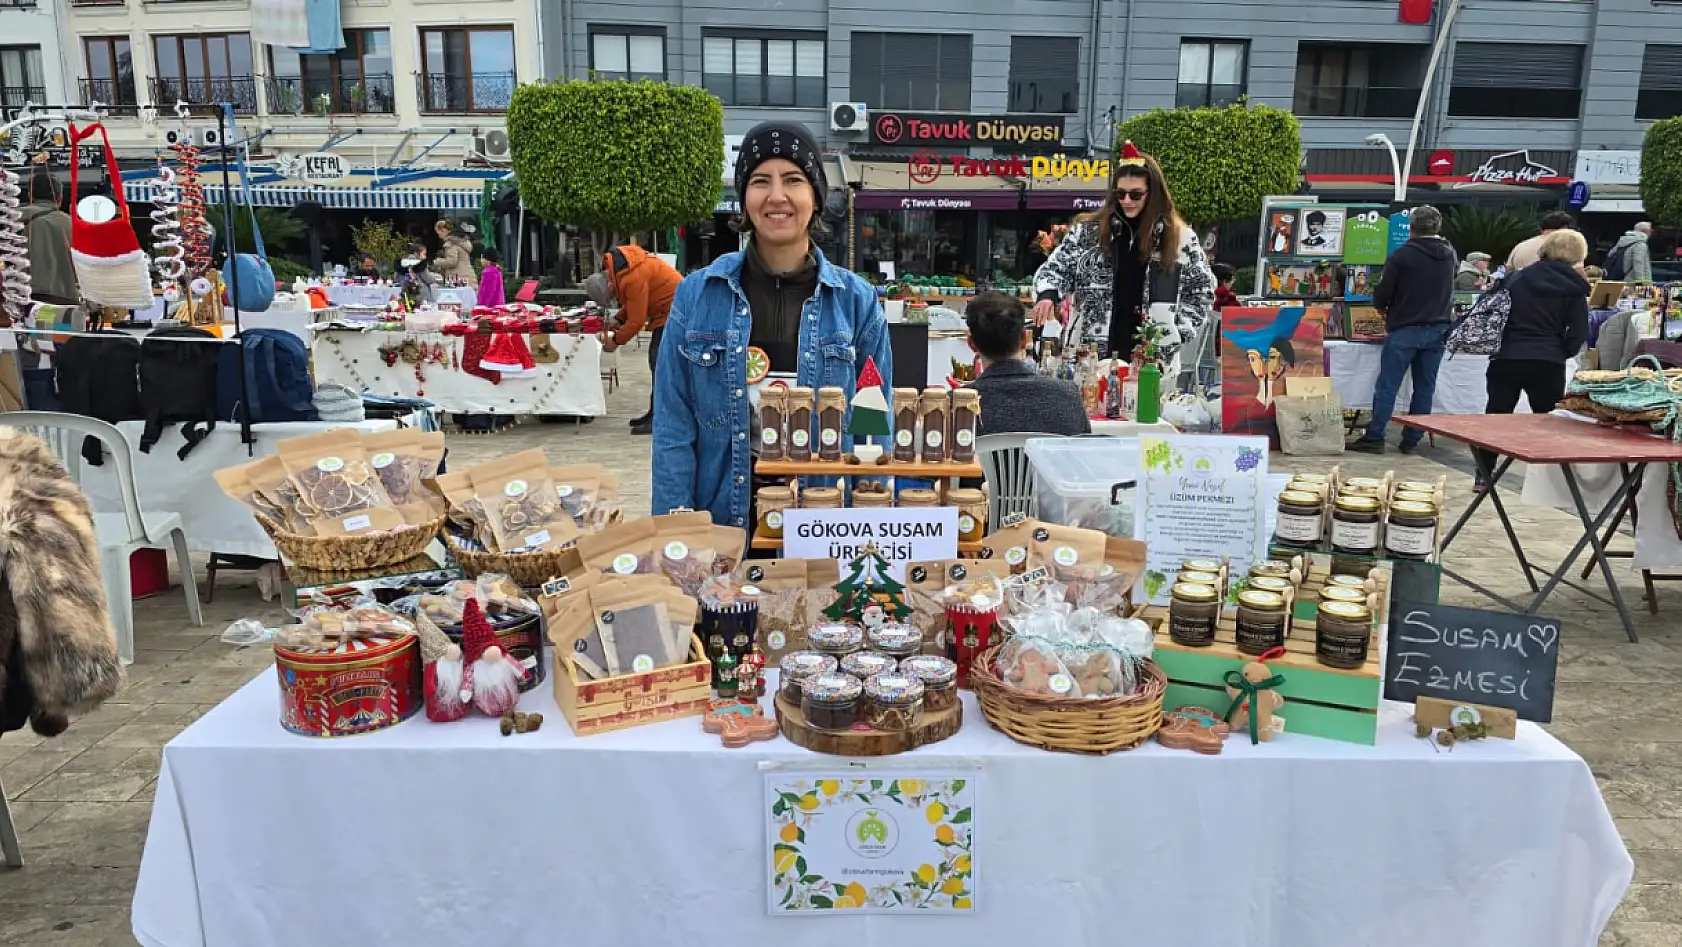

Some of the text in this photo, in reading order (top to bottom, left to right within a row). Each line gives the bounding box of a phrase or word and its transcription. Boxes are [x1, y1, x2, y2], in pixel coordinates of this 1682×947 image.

[907, 119, 1059, 144] Tavuk Dünyası
[306, 156, 343, 173] KEFAL
[949, 154, 1027, 179] Tavuk
[1472, 164, 1541, 182] Pizza Hut
[912, 199, 936, 207] Tavuk
[1170, 492, 1195, 502] ÜZÜM
[797, 520, 943, 538] GÖKOVA SUSAM
[1400, 611, 1528, 657] SUSAM
